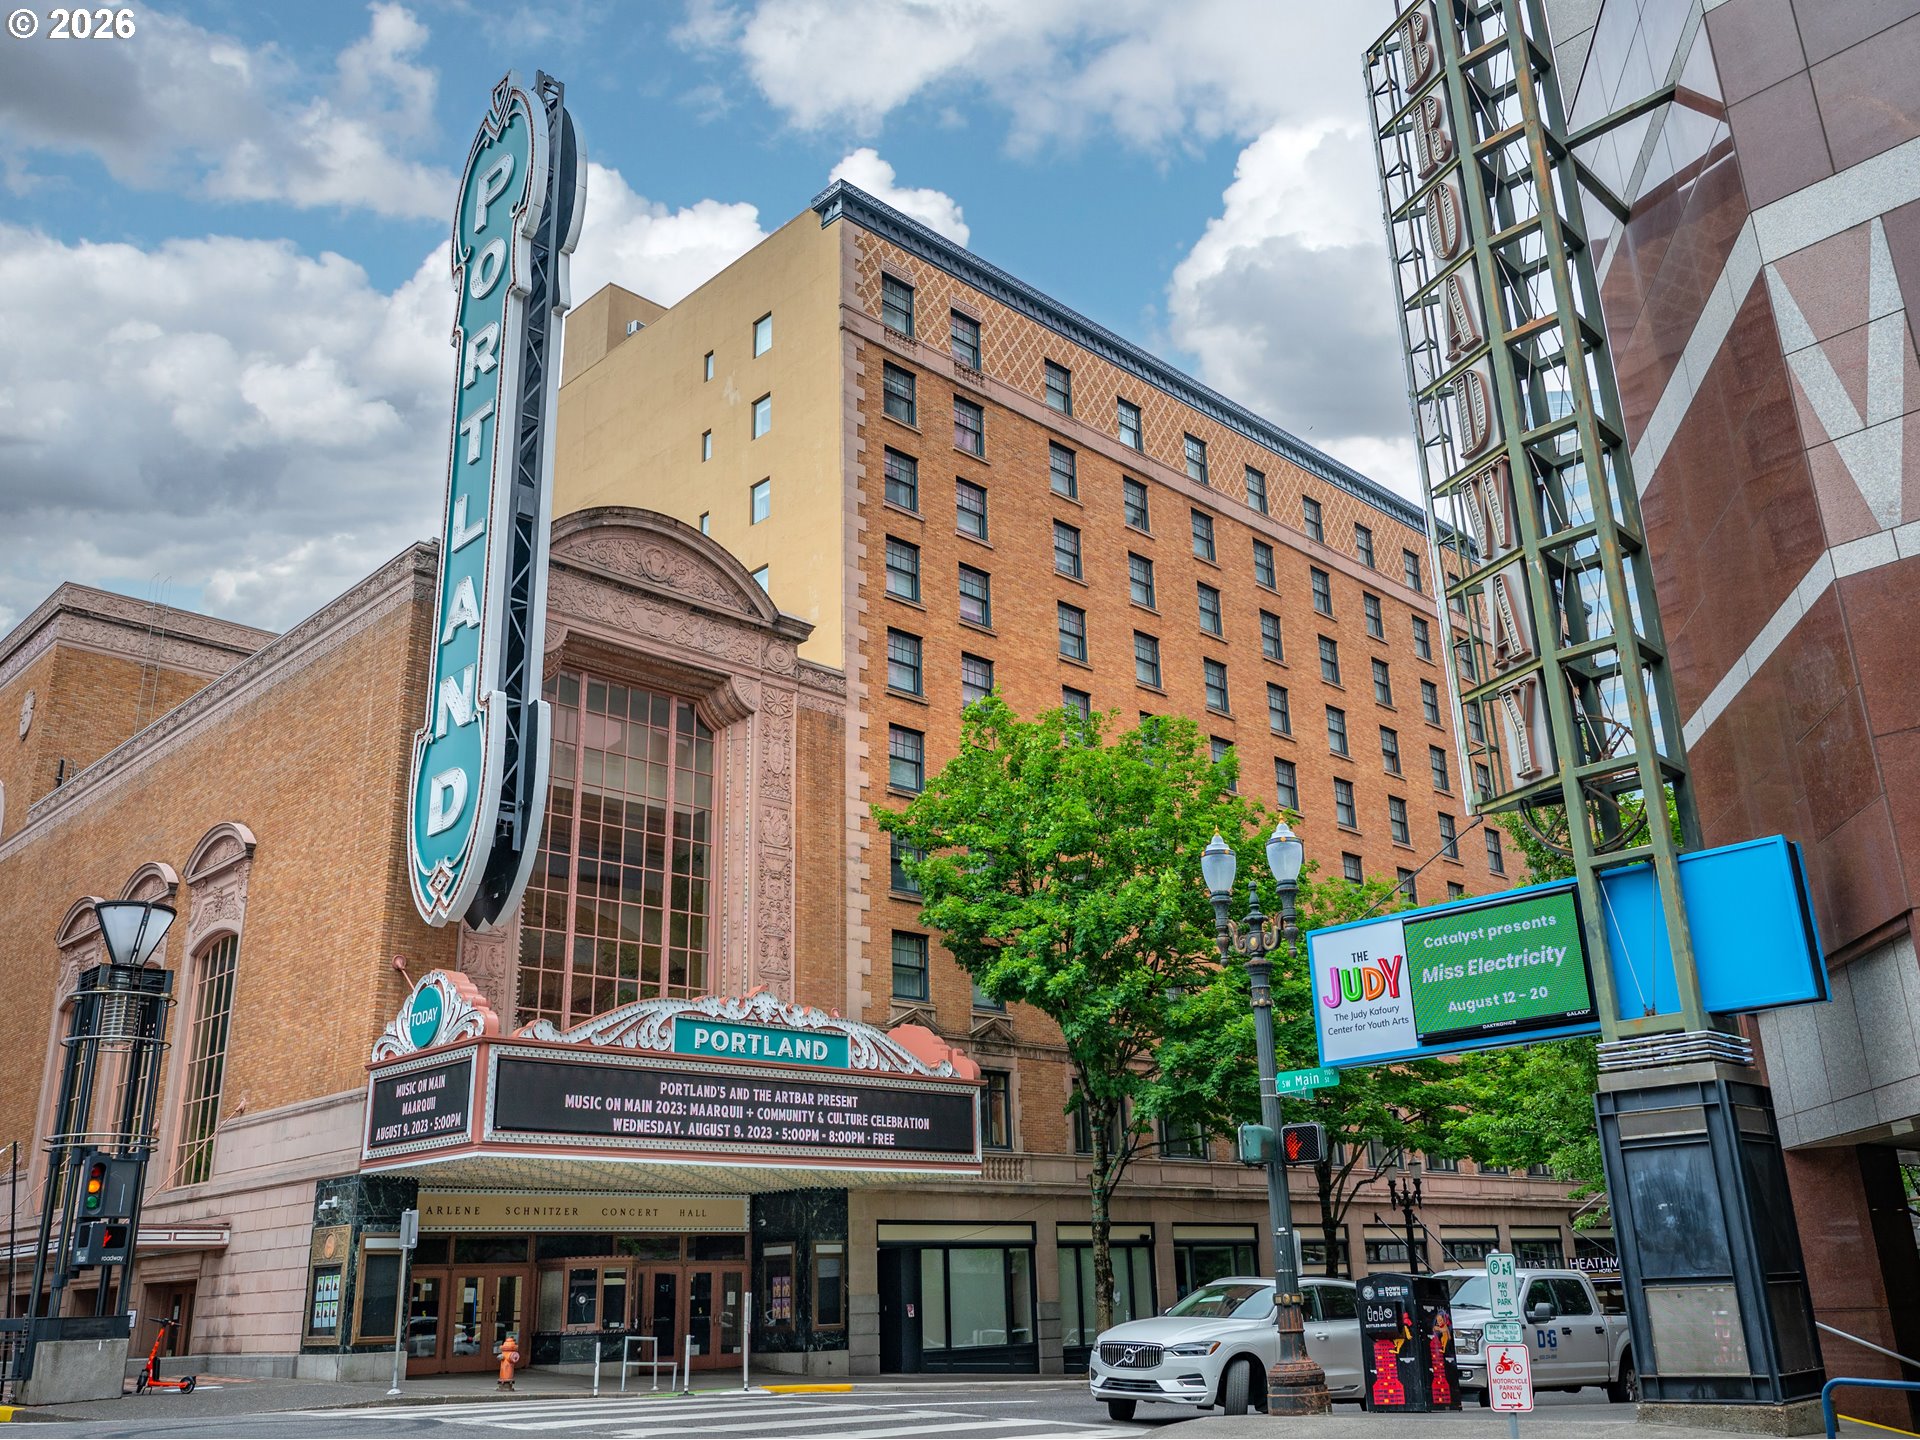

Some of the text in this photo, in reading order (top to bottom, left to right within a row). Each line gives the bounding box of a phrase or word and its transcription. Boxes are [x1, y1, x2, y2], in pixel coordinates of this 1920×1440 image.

[1400, 11, 1542, 779] BROADWAY
[427, 153, 515, 836] PORTLAND
[1423, 914, 1558, 949] Catalyst presents
[1351, 950, 1369, 963] THE
[1422, 944, 1567, 984] Miss Electricity
[1322, 954, 1403, 1009] JUDY
[1448, 994, 1500, 1014] August
[1502, 991, 1517, 1004] 12
[1530, 986, 1549, 1000] 20
[411, 1006, 438, 1027] TODAY
[1334, 1004, 1400, 1022] The Judy Kafoury
[1566, 1008, 1590, 1018] GALAXY
[1327, 1015, 1410, 1036] Center for Youth Arts
[1482, 1019, 1517, 1030] DAKTRONICS
[694, 1027, 829, 1061] PORTLAND
[395, 1074, 446, 1098] MUSIC ON MAIN
[1281, 1079, 1291, 1089] SW
[1295, 1072, 1320, 1087] Main
[729, 1087, 750, 1101] AND
[753, 1088, 772, 1103] THE
[774, 1090, 815, 1106] ARTBAR
[817, 1094, 859, 1109] PRESENT
[564, 1093, 602, 1110] MUSIC
[605, 1097, 621, 1111] ON
[624, 1098, 652, 1114] MAIN
[655, 1100, 687, 1116] 2023:
[689, 1102, 744, 1119] MAARQUII
[756, 1107, 815, 1125] COMMUNITY
[817, 1113, 825, 1124] &
[827, 1112, 869, 1127] CULTURE
[870, 1114, 930, 1131] CELEBRATION
[375, 1123, 402, 1141] AUGUST
[411, 1118, 429, 1135] 2023
[433, 1112, 461, 1131] 5:00PM
[687, 1121, 731, 1137] AUGUST
[747, 1125, 773, 1140] 2023
[781, 1127, 819, 1142] 5:00PM
[828, 1130, 865, 1145] 8:00PM
[872, 1131, 895, 1146] FREE
[425, 1205, 707, 1218] ARLENE SCHNITZER CONCERT HALL
[1497, 1281, 1508, 1290] PAY
[1499, 1289, 1508, 1298] TO
[1497, 1298, 1513, 1306] PARK
[1501, 1391, 1522, 1400] ONLY
